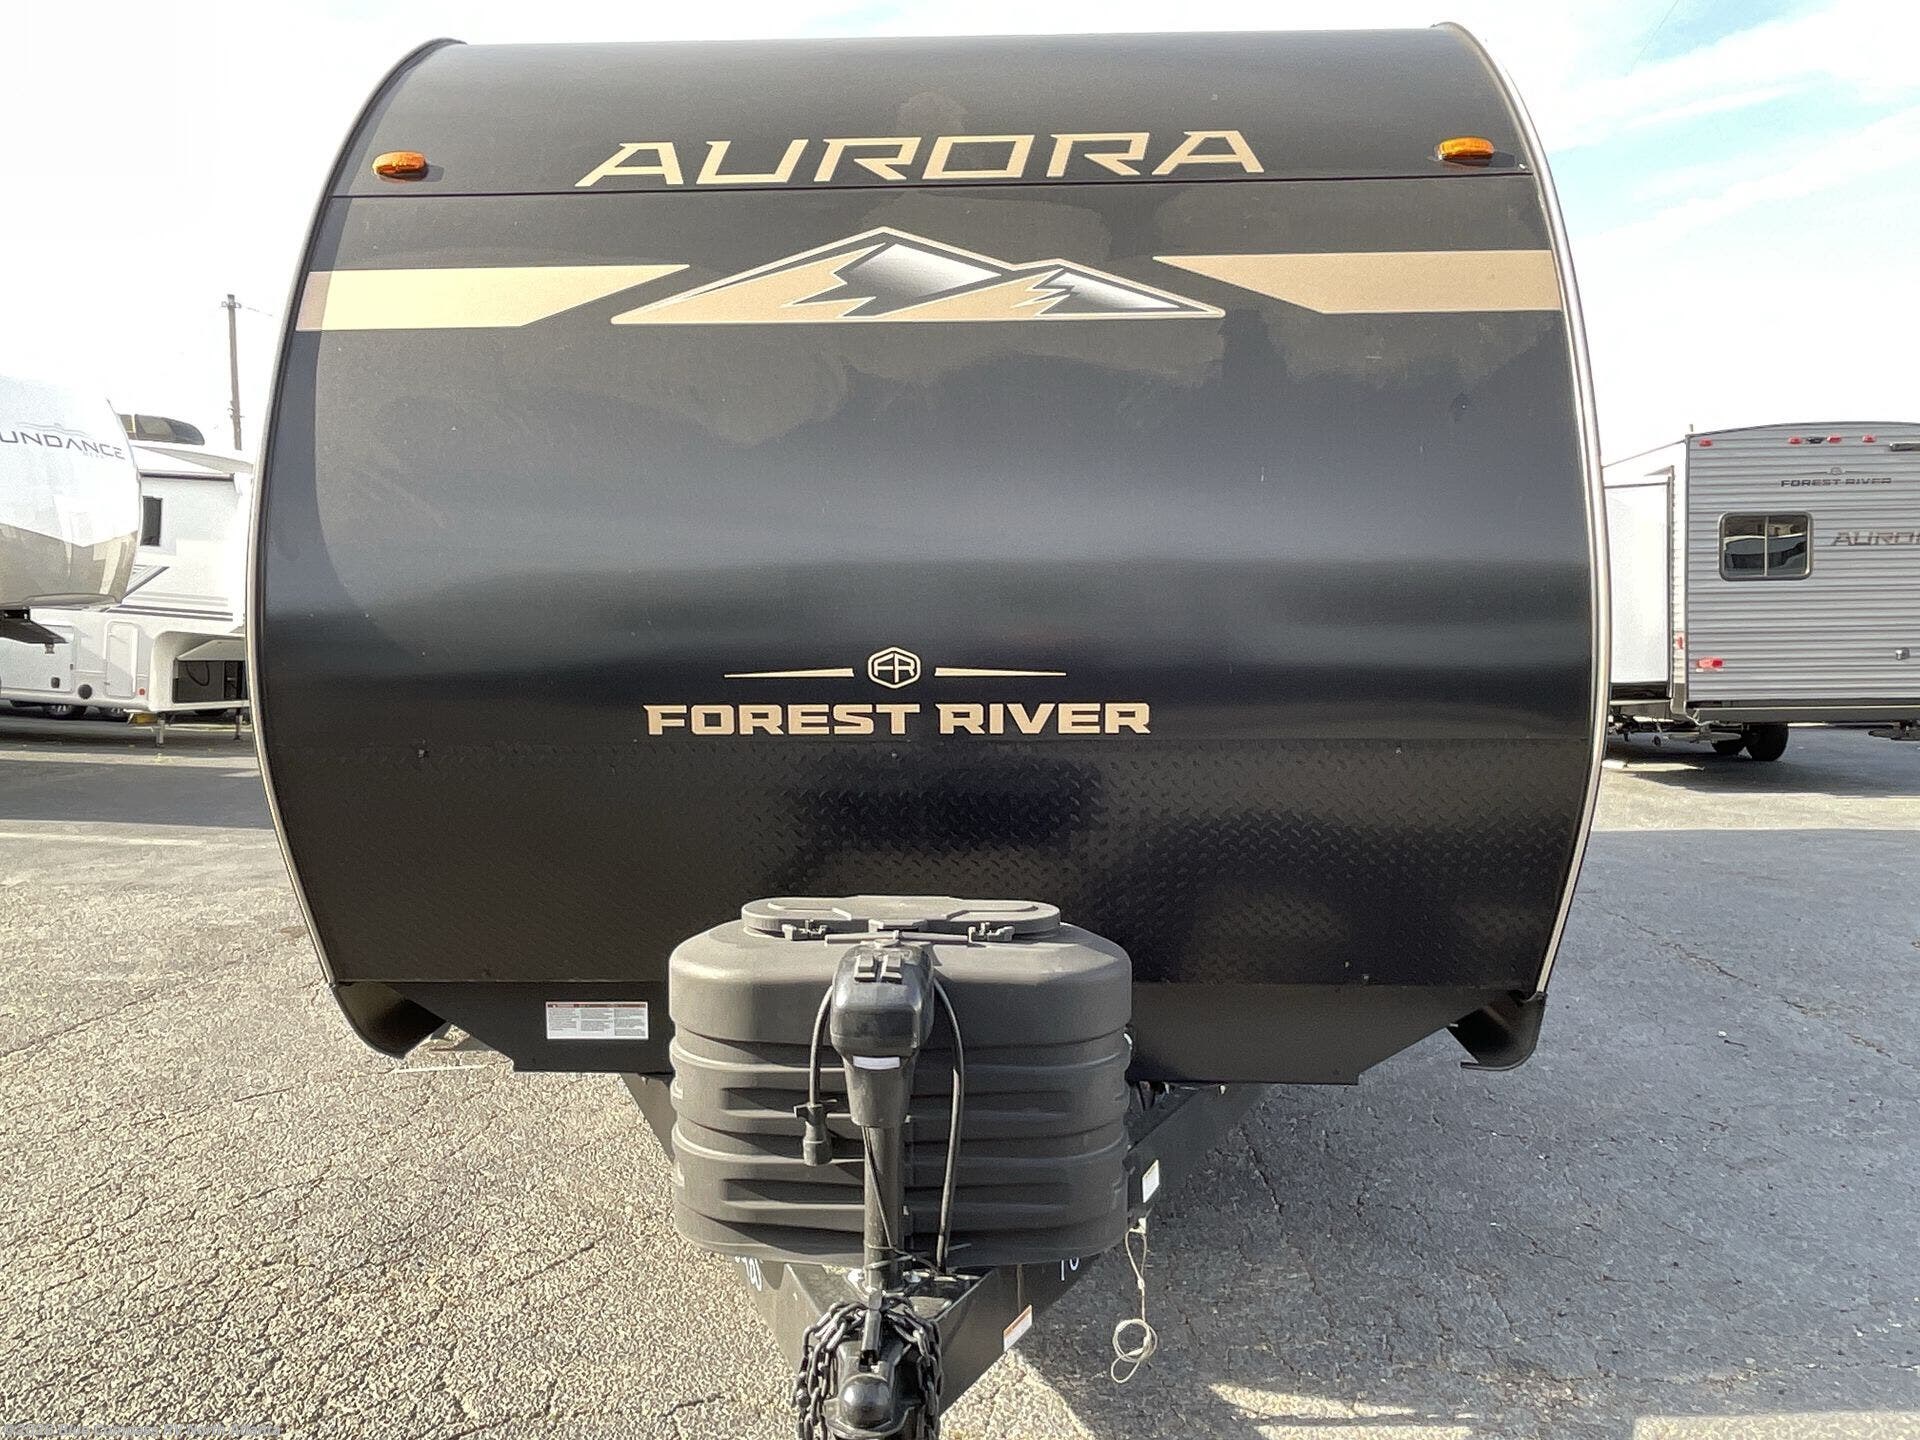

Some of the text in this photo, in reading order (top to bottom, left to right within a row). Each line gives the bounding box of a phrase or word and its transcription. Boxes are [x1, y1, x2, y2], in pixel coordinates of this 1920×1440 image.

[574, 130, 1265, 187] AURORA
[1780, 477, 1892, 487] FOREST RIVER
[1831, 532, 1920, 546] AURO
[643, 702, 1152, 735] FOREST RIVER
